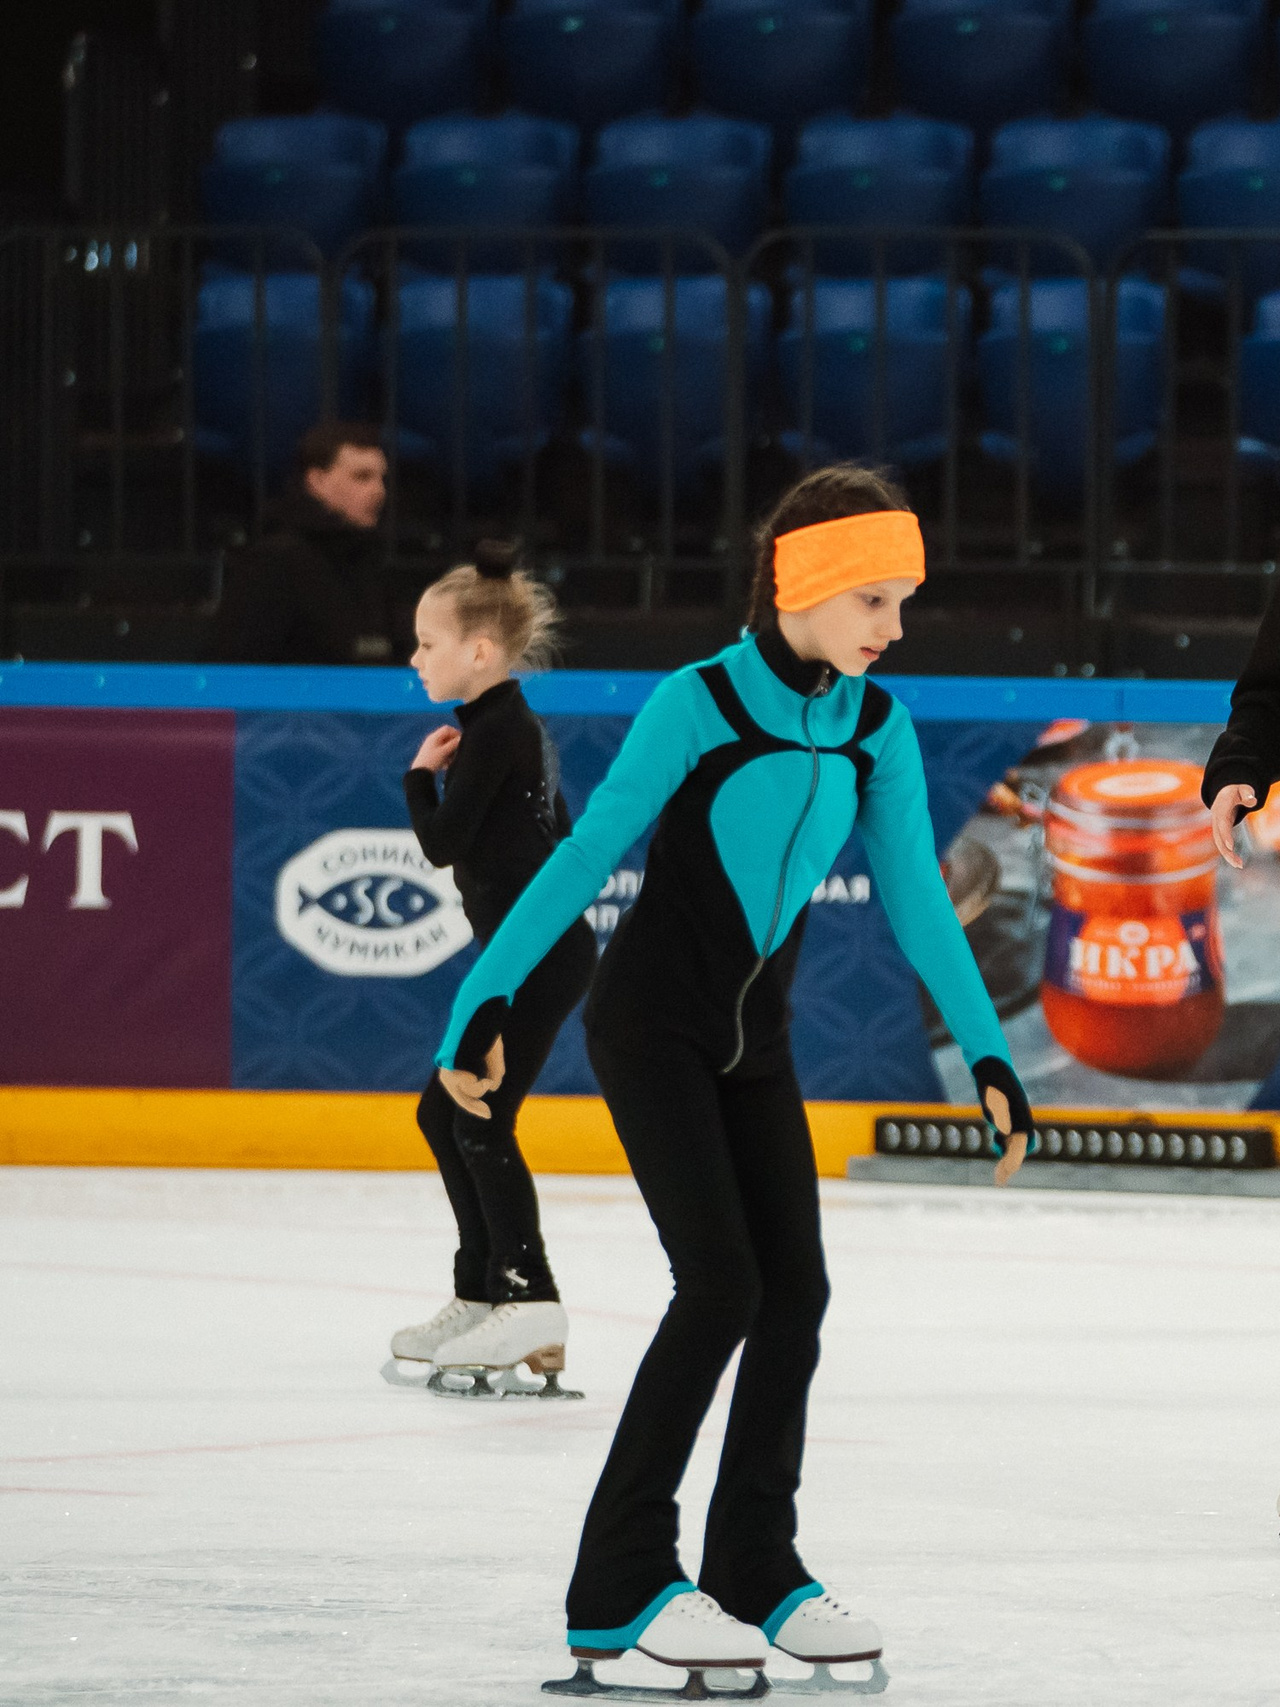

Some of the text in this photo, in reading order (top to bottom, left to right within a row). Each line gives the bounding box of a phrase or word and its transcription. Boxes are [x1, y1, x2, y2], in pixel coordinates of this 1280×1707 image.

[352, 875, 404, 927] SC
[316, 924, 447, 960] ЧУМИКАН
[1069, 936, 1199, 980] ИКРА
